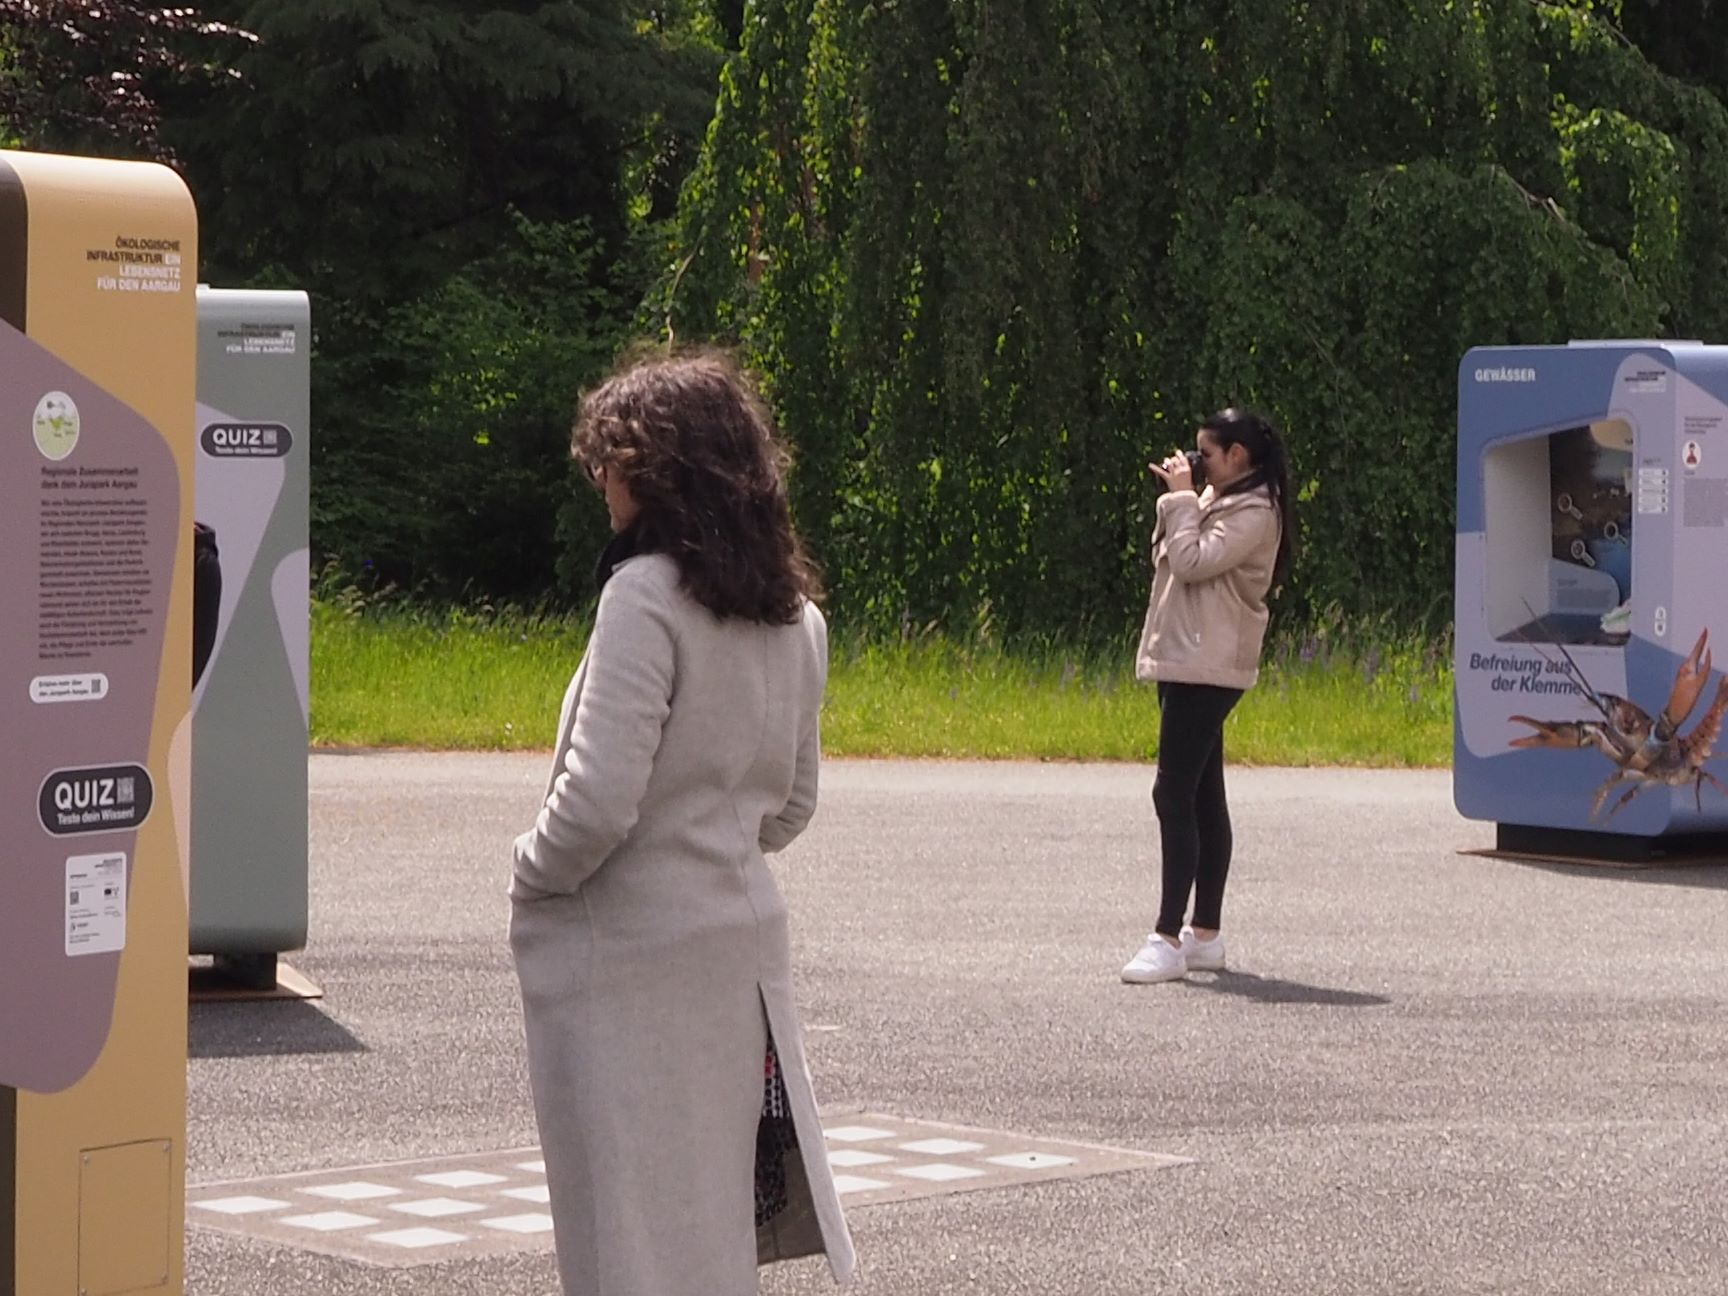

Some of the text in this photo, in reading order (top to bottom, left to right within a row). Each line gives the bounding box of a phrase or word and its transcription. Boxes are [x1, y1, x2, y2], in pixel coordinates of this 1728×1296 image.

[116, 236, 180, 251] ÖKOLOGISCHE
[87, 251, 162, 263] INFRASTRUKTUR
[97, 277, 180, 291] FÜR DEN AARGAU
[1475, 367, 1536, 382] GEWÄSSER
[213, 428, 261, 445] QUIZ
[1470, 653, 1572, 674] Befreiung aus
[1491, 675, 1581, 695] der Klemme
[55, 778, 114, 810] QUIZ
[57, 807, 135, 825] Teste dein Wissen!
